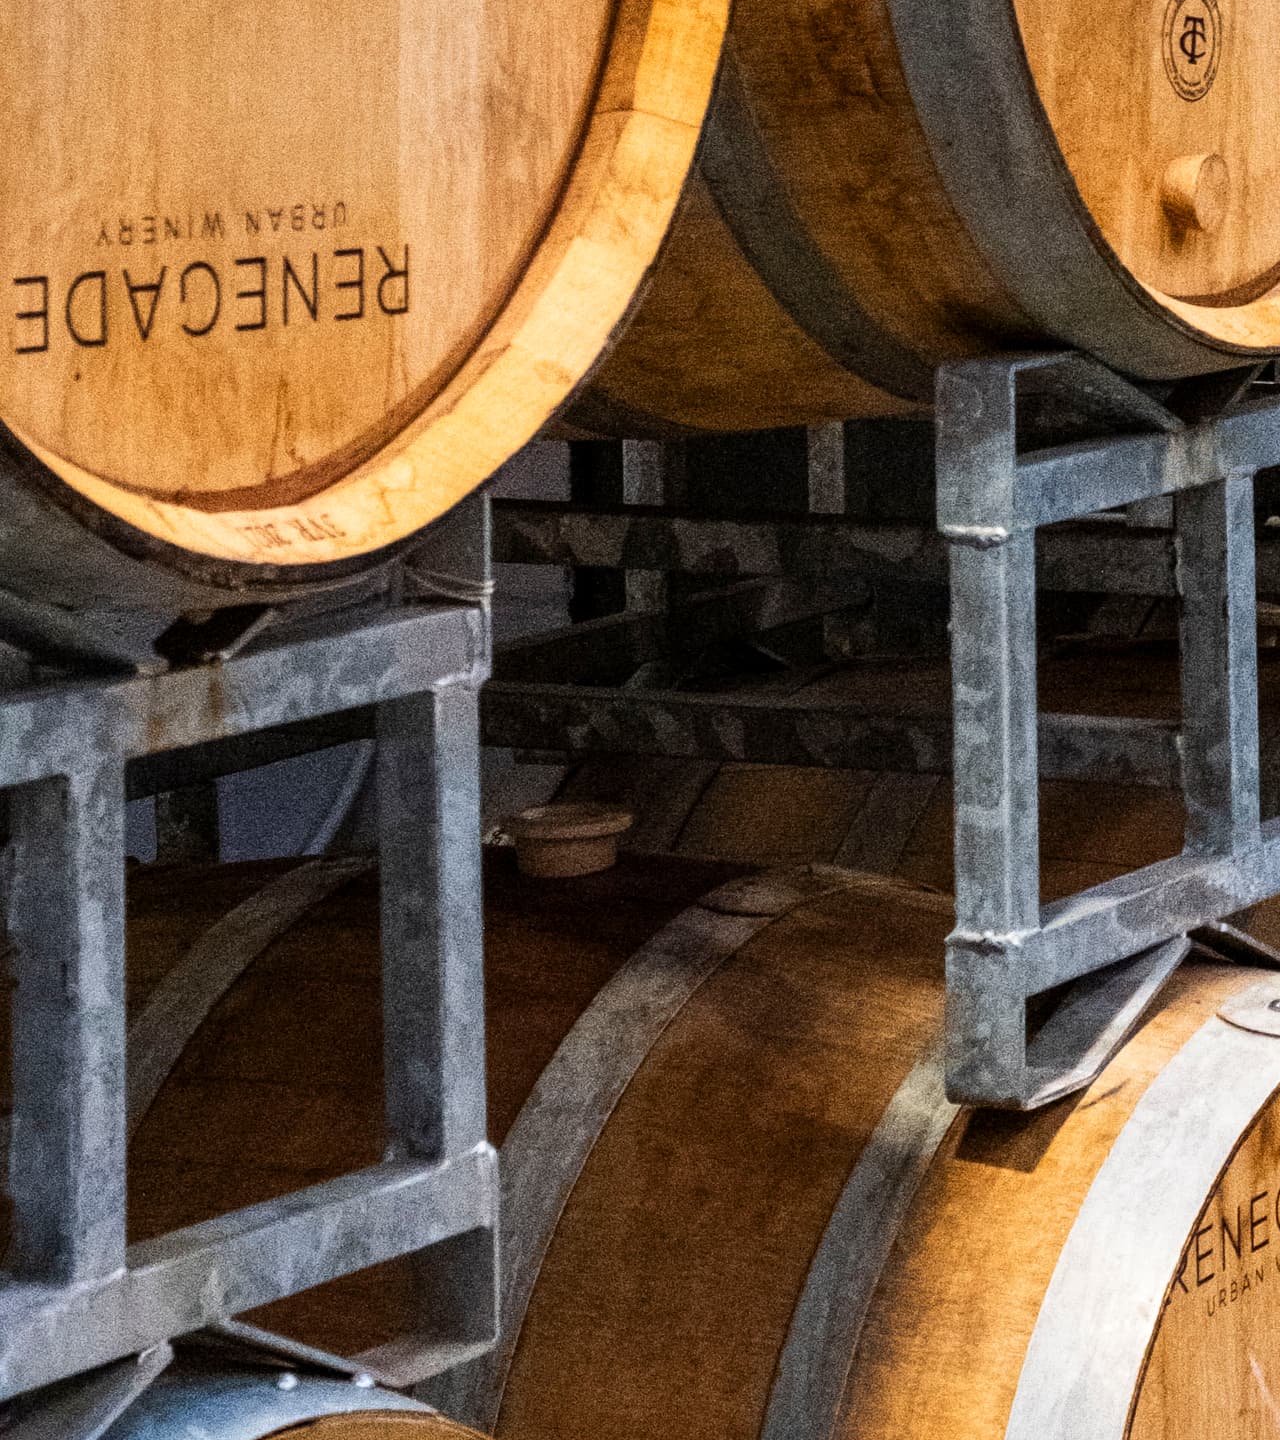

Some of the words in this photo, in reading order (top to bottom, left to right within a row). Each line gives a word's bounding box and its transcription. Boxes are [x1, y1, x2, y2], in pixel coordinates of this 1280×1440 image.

[98, 210, 227, 246] WINERY
[245, 201, 347, 233] URBAN
[12, 243, 410, 355] RENEGADE
[1205, 1266, 1265, 1318] URBAN
